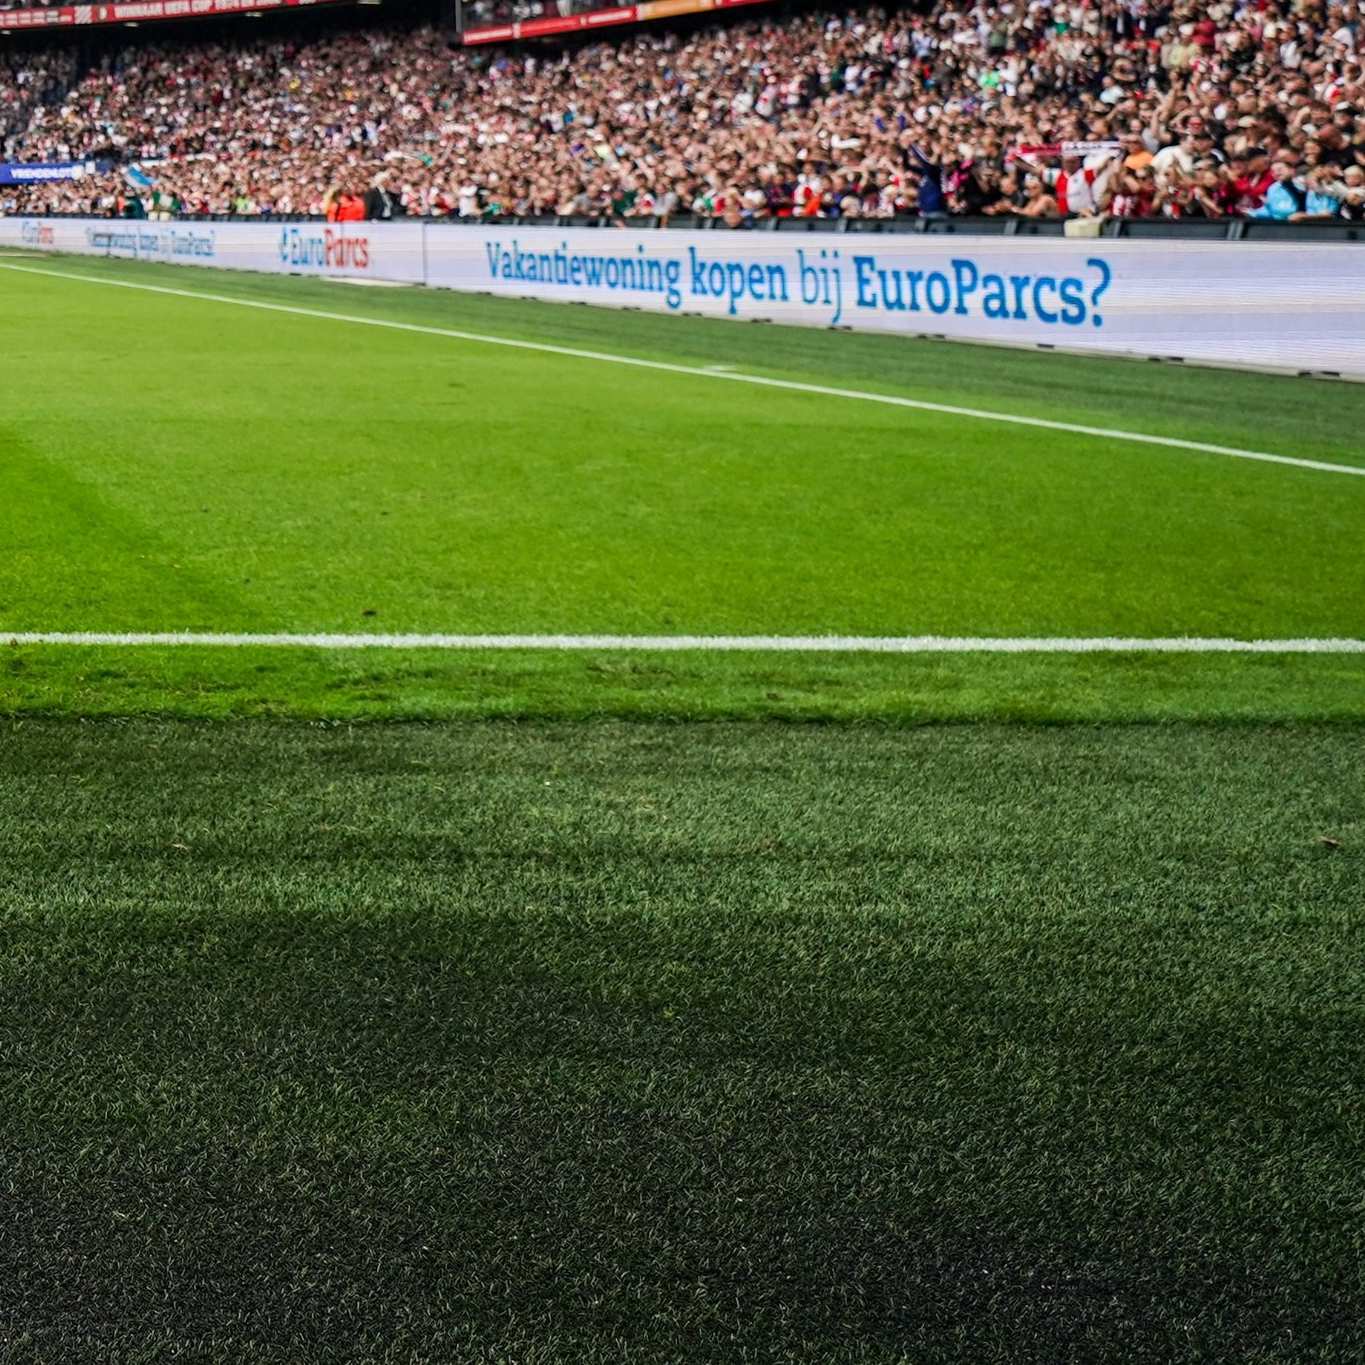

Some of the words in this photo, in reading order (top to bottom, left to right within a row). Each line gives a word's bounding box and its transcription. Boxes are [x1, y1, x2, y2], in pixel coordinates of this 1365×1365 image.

[291, 227, 368, 268] EuroParcs
[485, 239, 681, 309] Vakantiewoning
[689, 245, 788, 314] kopen
[797, 248, 843, 325] bij
[854, 255, 1113, 327] EuroParcs?
